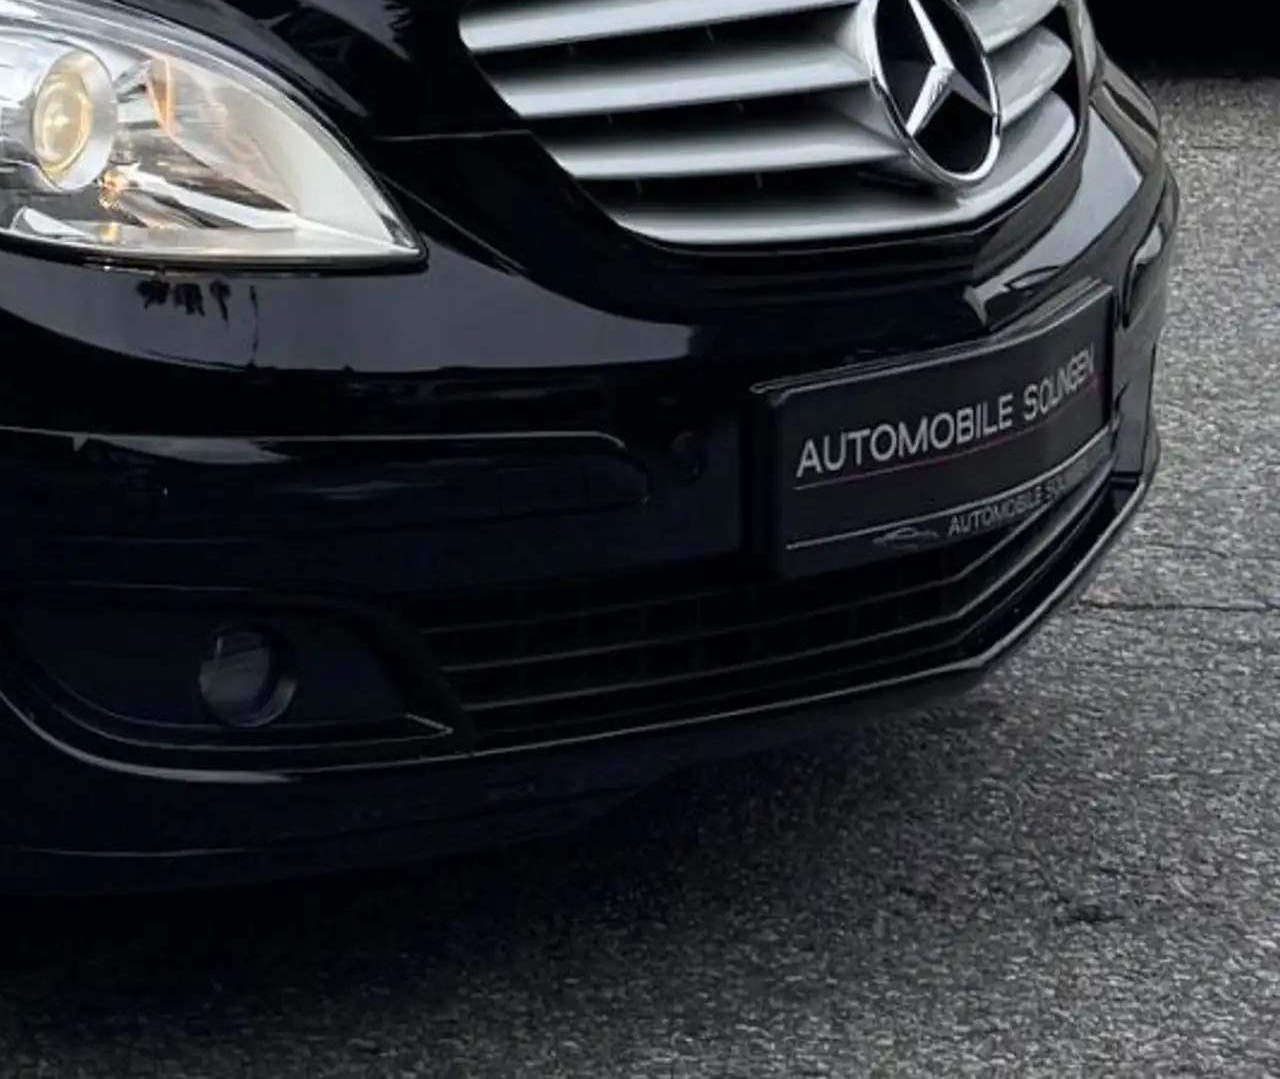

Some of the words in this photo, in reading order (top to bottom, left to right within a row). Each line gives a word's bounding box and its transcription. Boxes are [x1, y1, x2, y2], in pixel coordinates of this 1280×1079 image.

[796, 392, 1014, 478] AUTOMOBILE
[1023, 342, 1096, 422] SOLINGEN
[948, 484, 1043, 537] AUTOMOBILE
